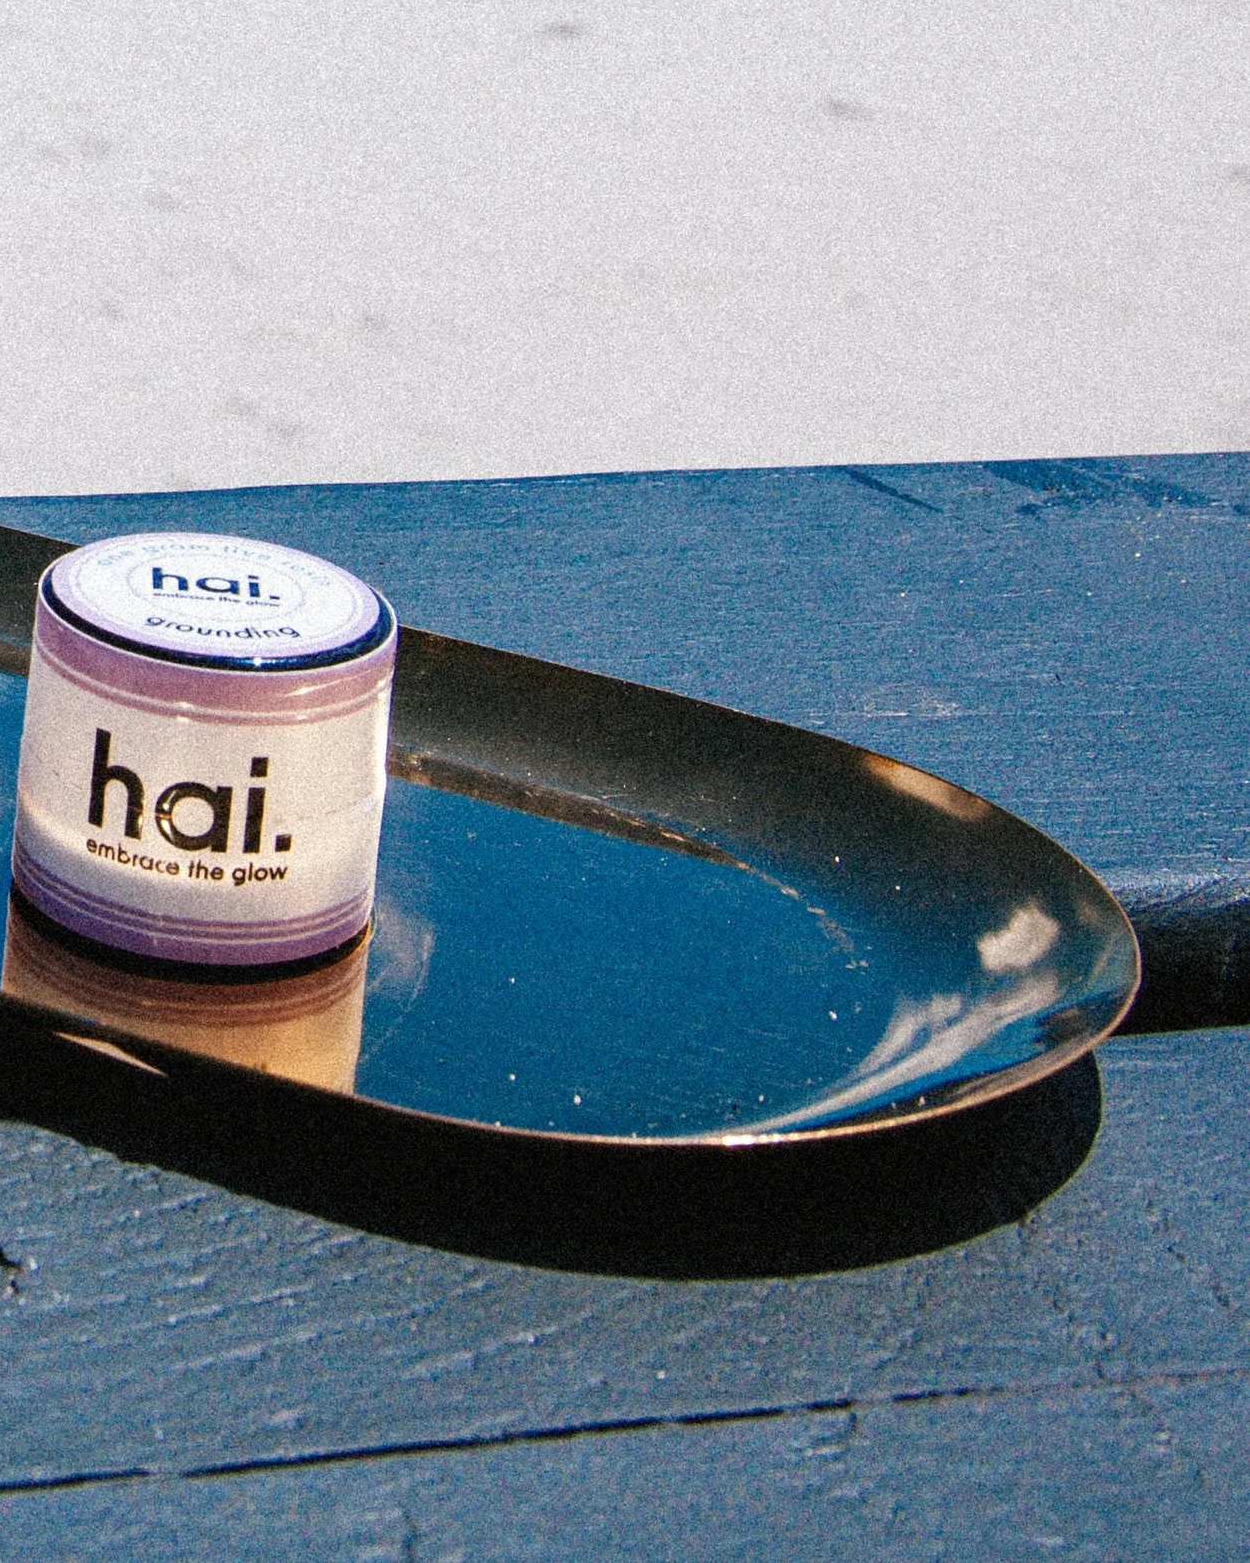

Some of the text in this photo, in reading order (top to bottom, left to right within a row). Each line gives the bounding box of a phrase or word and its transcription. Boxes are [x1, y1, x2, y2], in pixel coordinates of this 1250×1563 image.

[152, 567, 281, 600] hai.
[144, 616, 301, 639] grounding
[87, 727, 293, 854] hai.
[85, 837, 289, 887] embrace the glow
